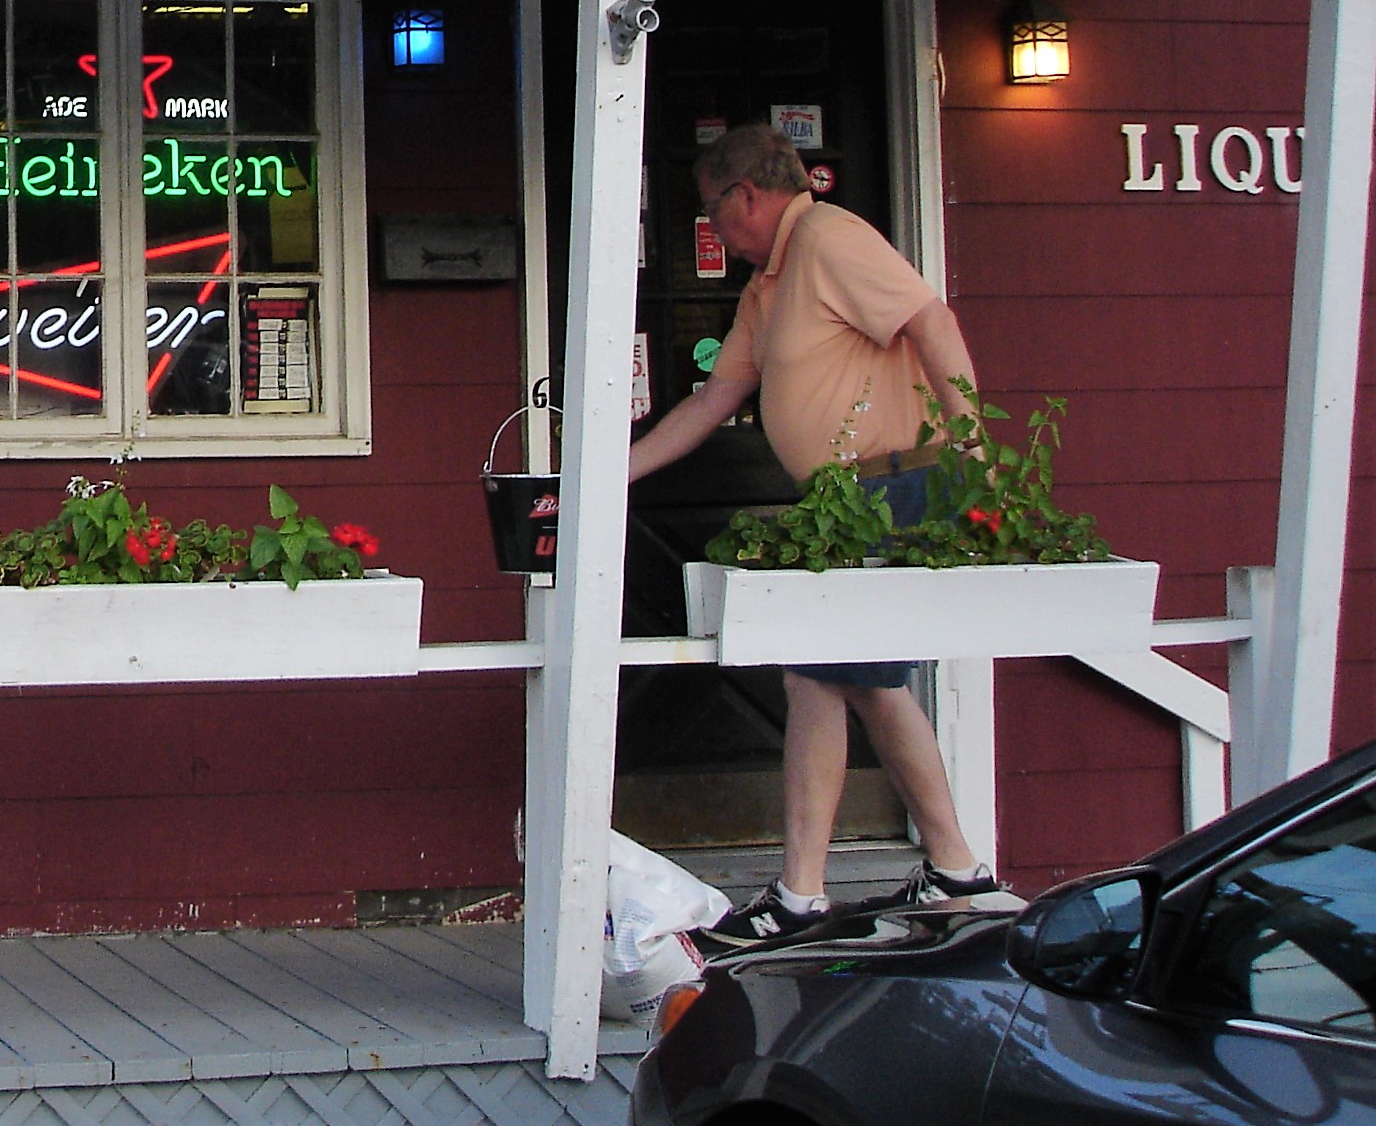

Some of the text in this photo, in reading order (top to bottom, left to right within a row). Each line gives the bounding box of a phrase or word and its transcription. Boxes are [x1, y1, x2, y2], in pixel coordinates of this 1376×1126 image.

[164, 97, 229, 119] MARK
[1120, 123, 1307, 195] LIQU
[531, 376, 550, 409] 6
[749, 911, 782, 939] N
